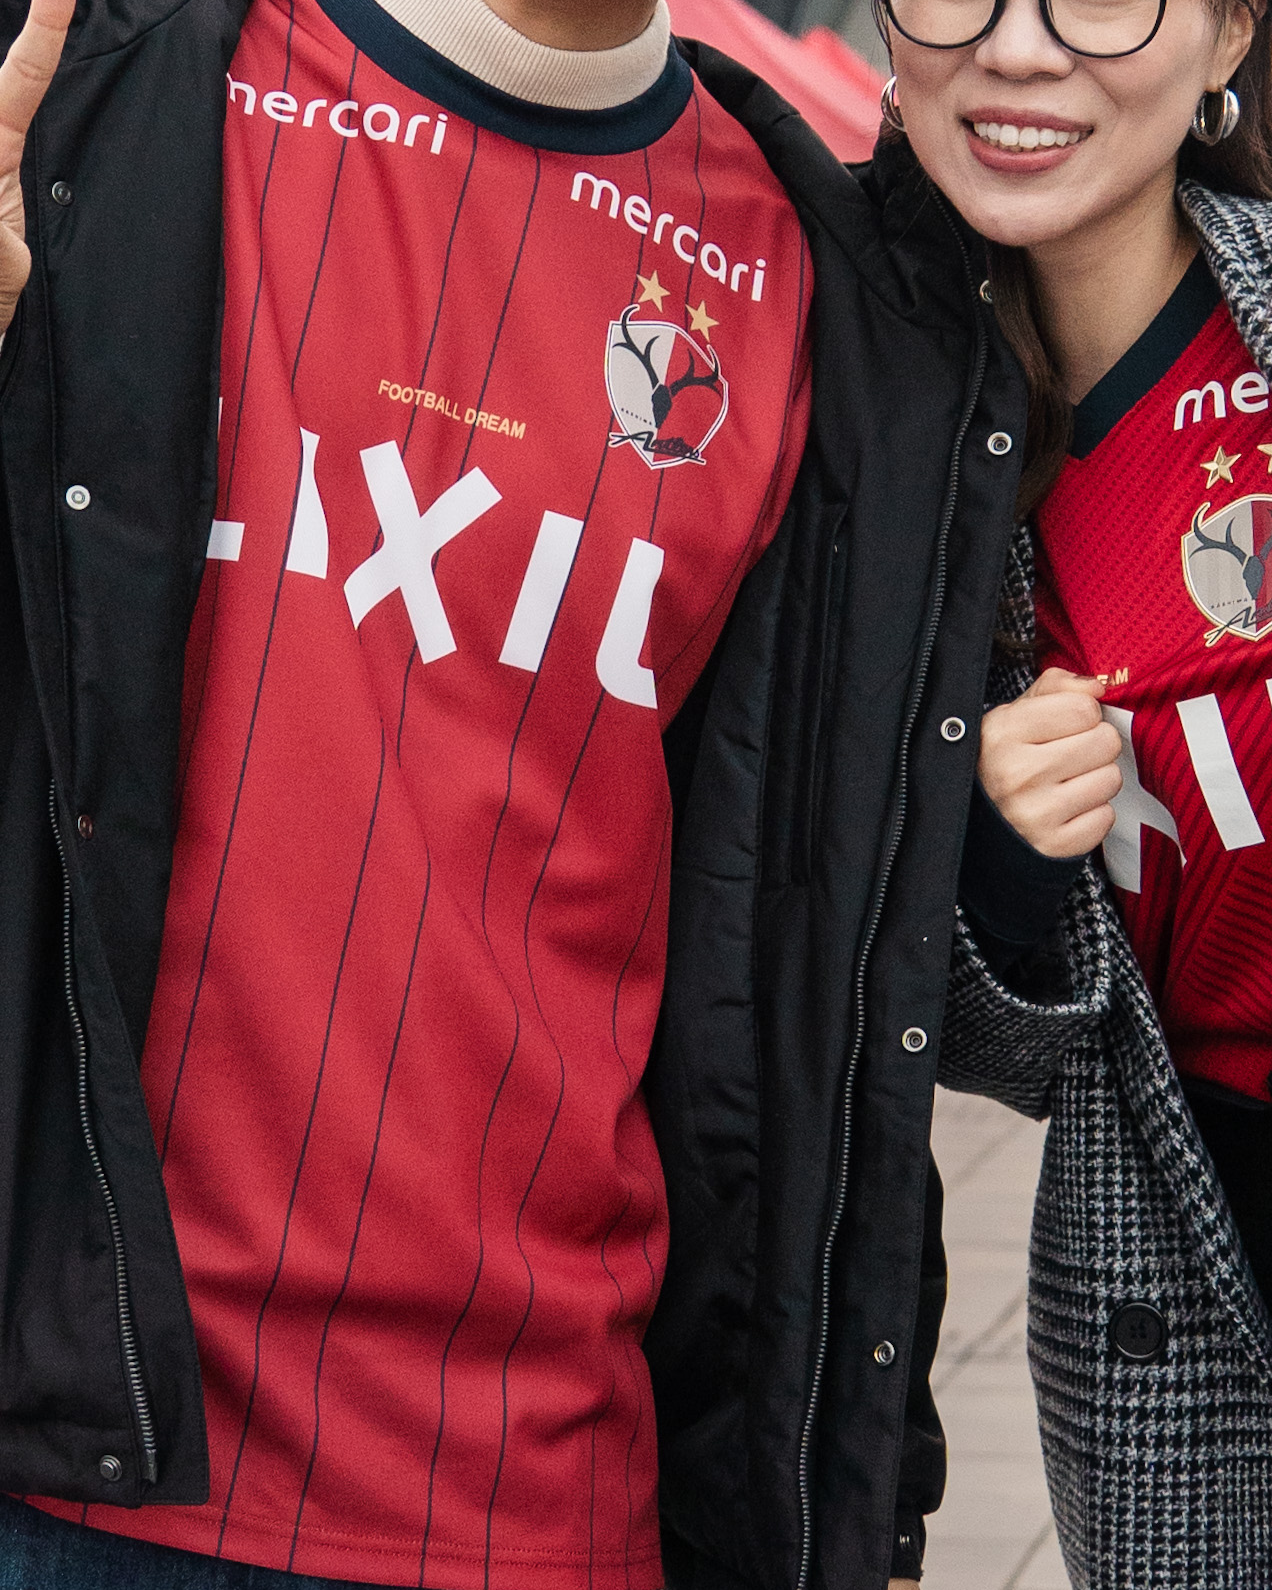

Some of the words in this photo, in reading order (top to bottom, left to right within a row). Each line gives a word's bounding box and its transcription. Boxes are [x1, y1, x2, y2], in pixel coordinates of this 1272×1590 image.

[570, 171, 766, 302] mercari
[378, 379, 461, 421] FOOTBALL
[464, 408, 526, 440] DREAM
